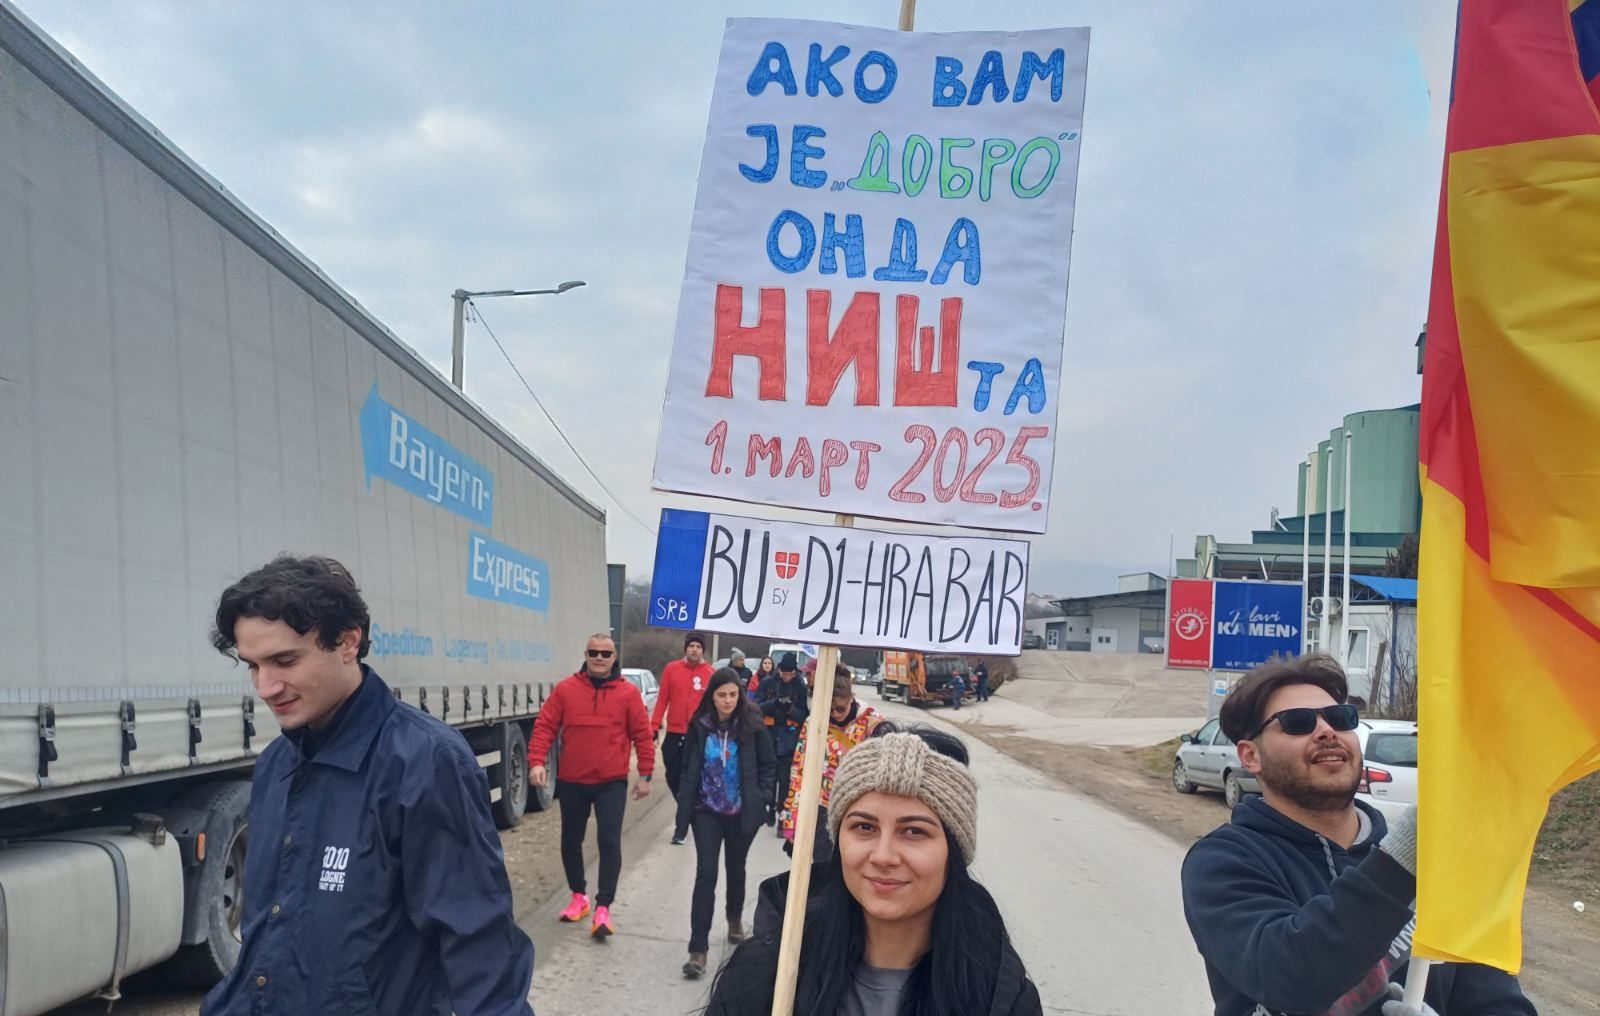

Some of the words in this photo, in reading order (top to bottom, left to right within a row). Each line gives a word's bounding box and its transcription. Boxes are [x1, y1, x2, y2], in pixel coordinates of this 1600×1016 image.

[746, 42, 898, 104] АКО
[932, 48, 1065, 107] ВАМ
[738, 124, 828, 188] ЈЕ
[766, 209, 981, 285] ОНДА
[389, 411, 490, 512] Bayern-
[705, 420, 732, 475] 1.
[745, 434, 881, 497] МАРТ
[888, 424, 1049, 511] 2025.
[472, 536, 540, 598] Express
[702, 525, 770, 623] BU
[772, 587, 789, 606] БУ
[656, 597, 688, 621] SRB
